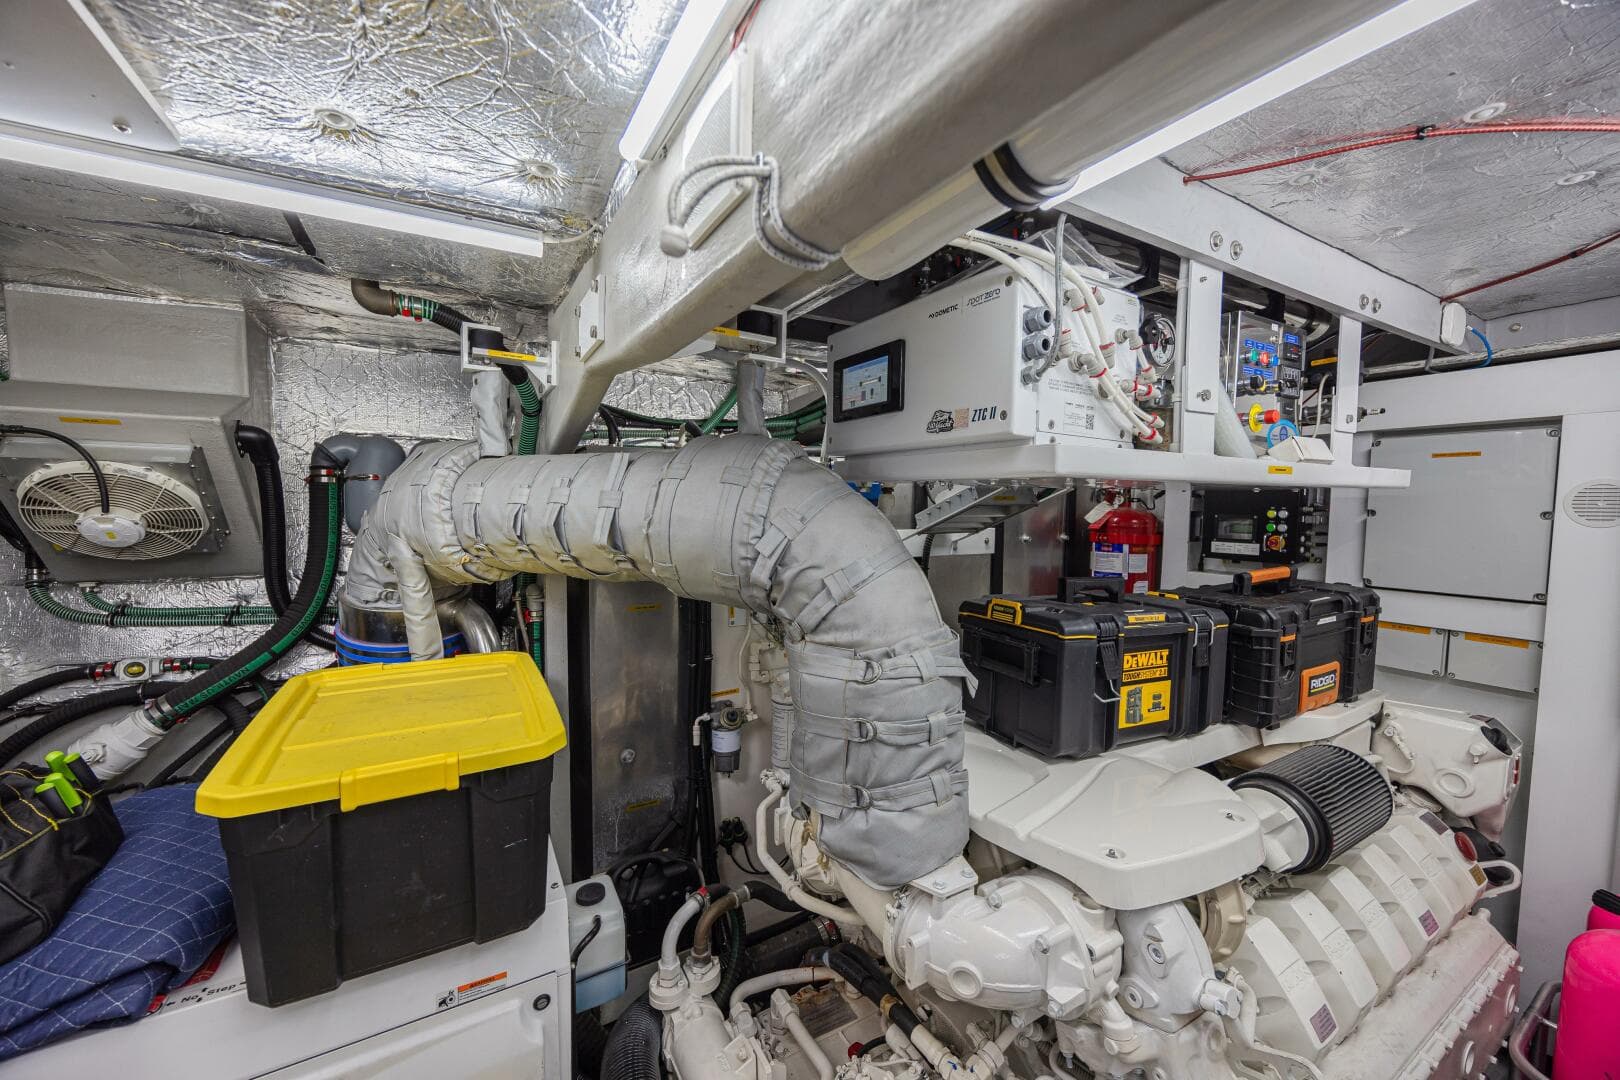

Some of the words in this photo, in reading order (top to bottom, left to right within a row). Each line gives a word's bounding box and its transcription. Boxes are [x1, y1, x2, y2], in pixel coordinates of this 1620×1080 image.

[934, 303, 960, 318] DOMETIC
[971, 407, 988, 422] ZTC
[200, 666, 250, 699] NAUTILUS
[1310, 673, 1336, 690] RIDGID
[181, 995, 199, 1003] No
[207, 984, 237, 996] Step
